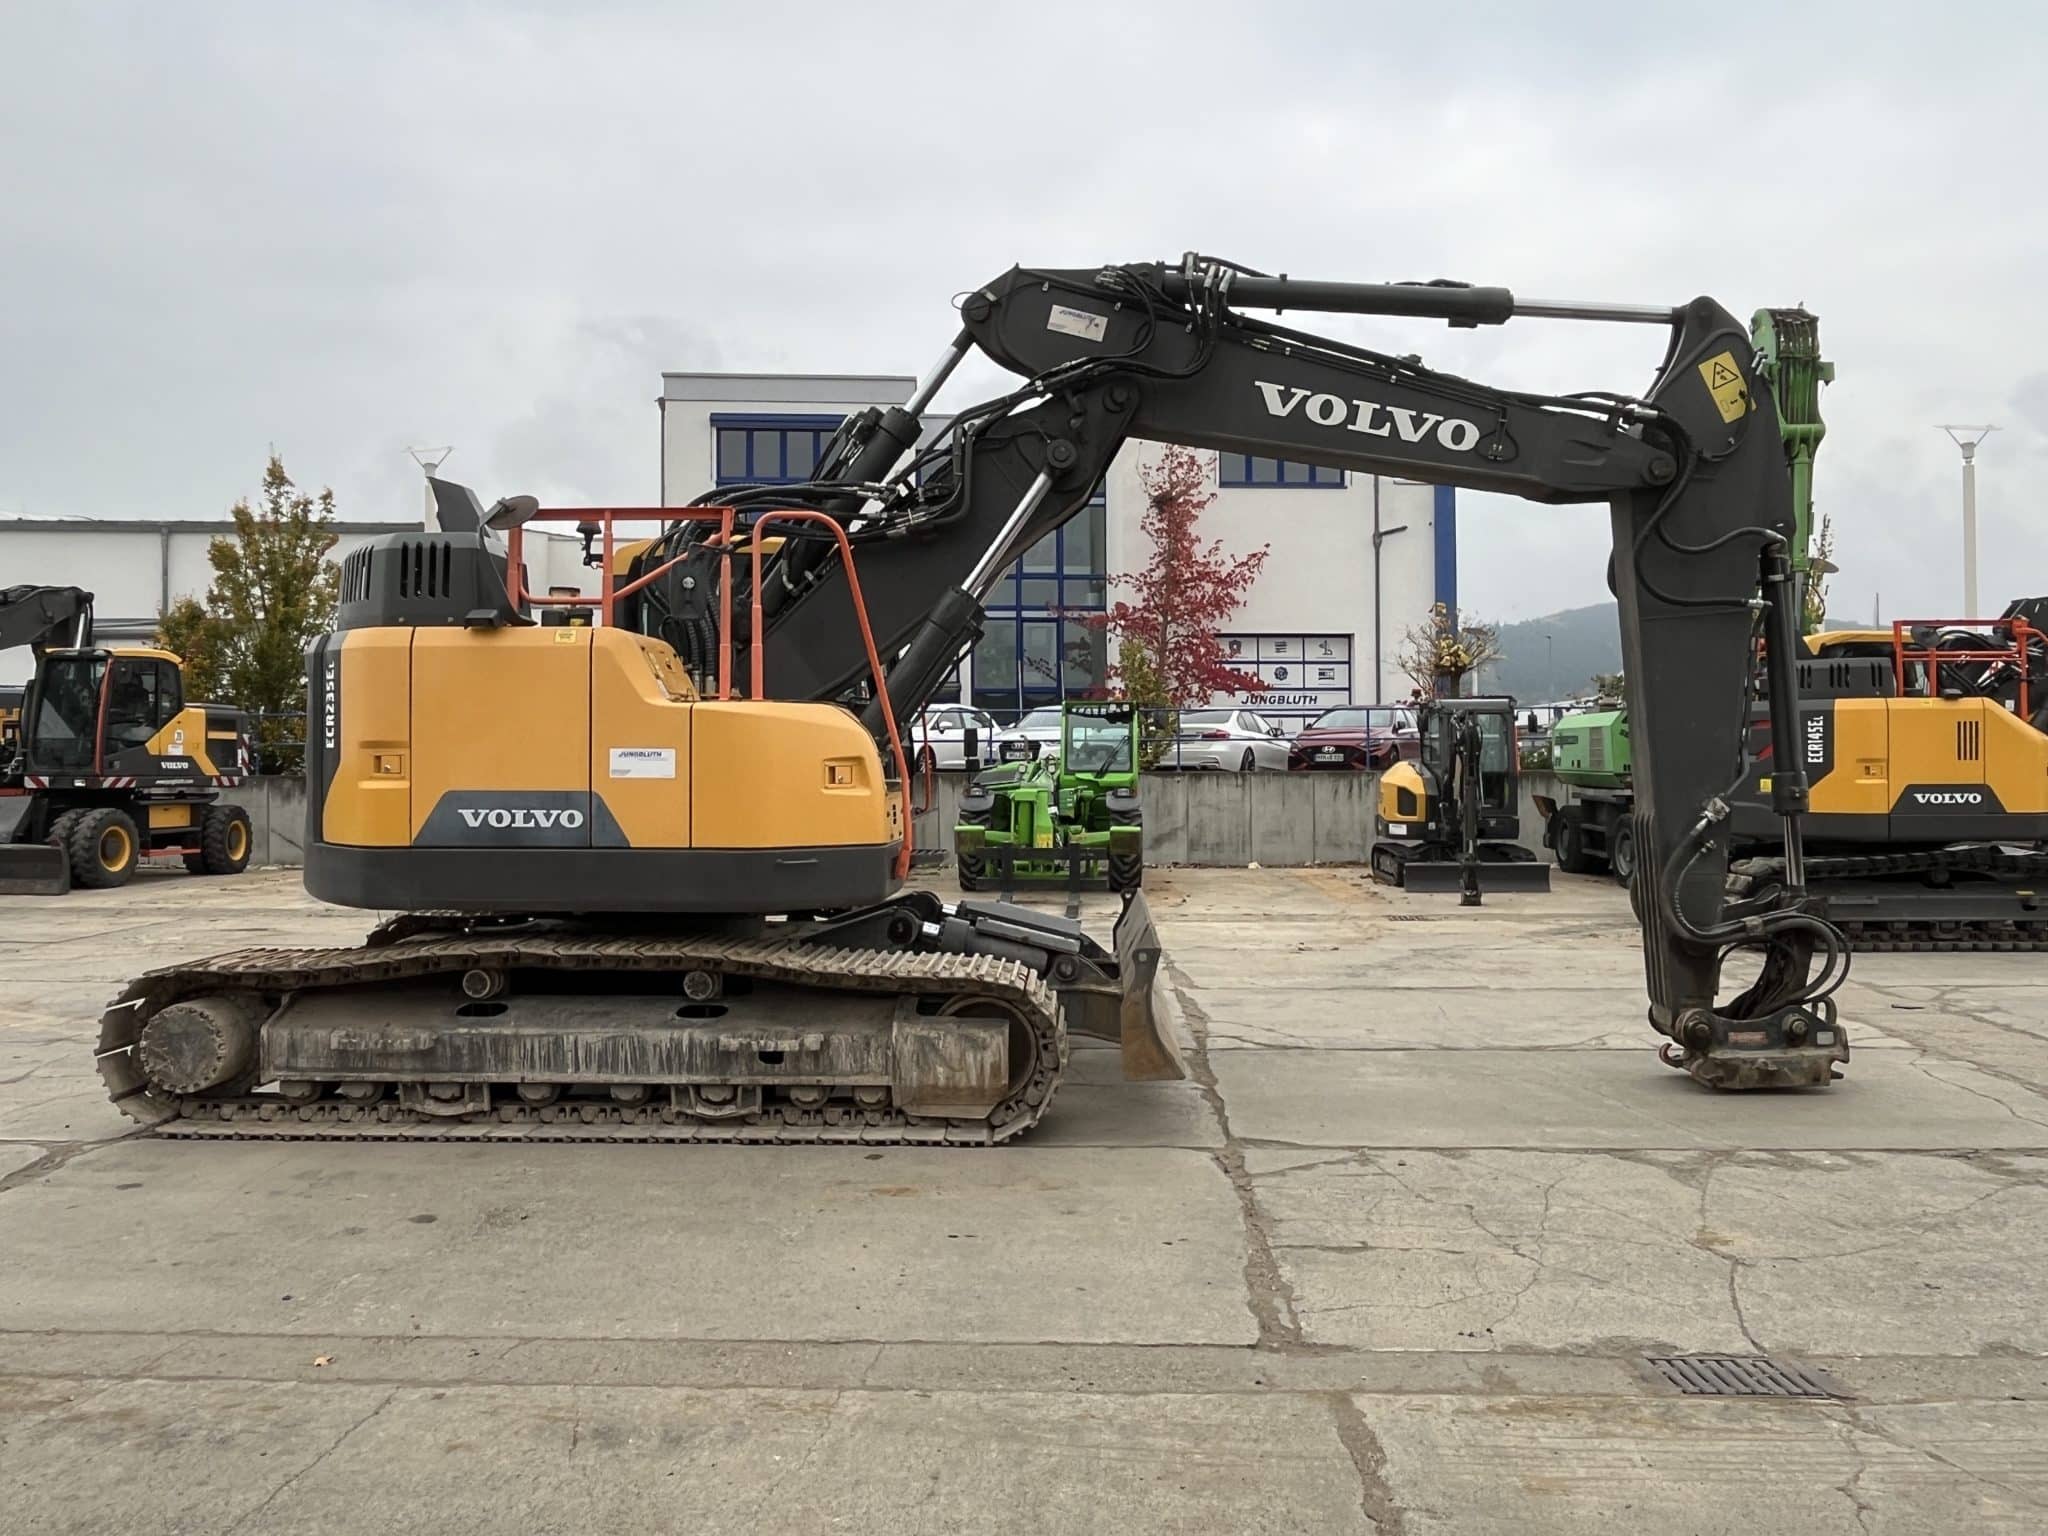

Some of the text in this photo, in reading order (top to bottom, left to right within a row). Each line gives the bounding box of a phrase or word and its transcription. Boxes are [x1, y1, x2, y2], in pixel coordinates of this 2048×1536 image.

[1255, 381, 1480, 450] VOLVO
[1241, 695, 1318, 705] JUNGBLUTH
[161, 761, 189, 769] VOLVO
[1913, 793, 1982, 804] VOLVO
[457, 809, 584, 828] VOLVO
